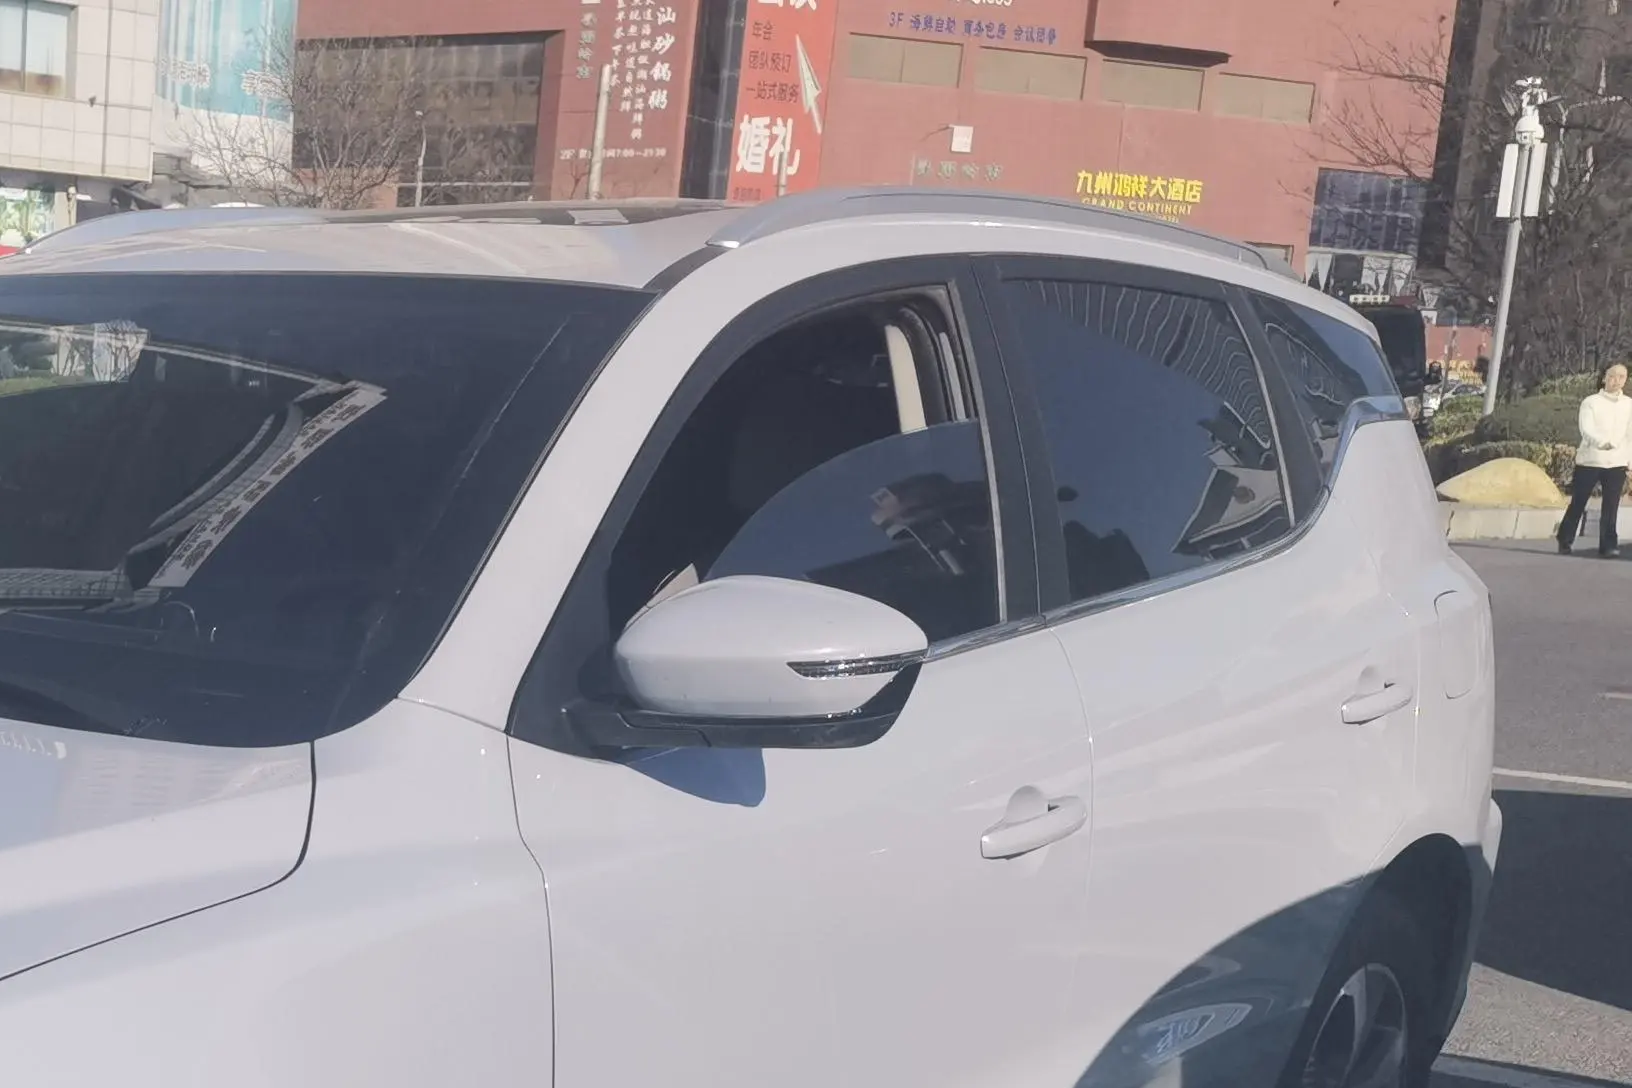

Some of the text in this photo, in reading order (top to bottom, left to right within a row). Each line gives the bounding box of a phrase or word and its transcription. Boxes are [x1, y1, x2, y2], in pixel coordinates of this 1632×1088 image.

[752, 21, 774, 41] 年会
[889, 12, 904, 28] 3F
[648, 7, 676, 110] 汕砂锅粥
[749, 50, 792, 73] 团队预订
[746, 81, 799, 103] 一站式服务
[735, 113, 801, 176] 婚礼
[1076, 170, 1204, 203] 九州鸿祥大酒店
[1129, 200, 1192, 215] CONTINENT
